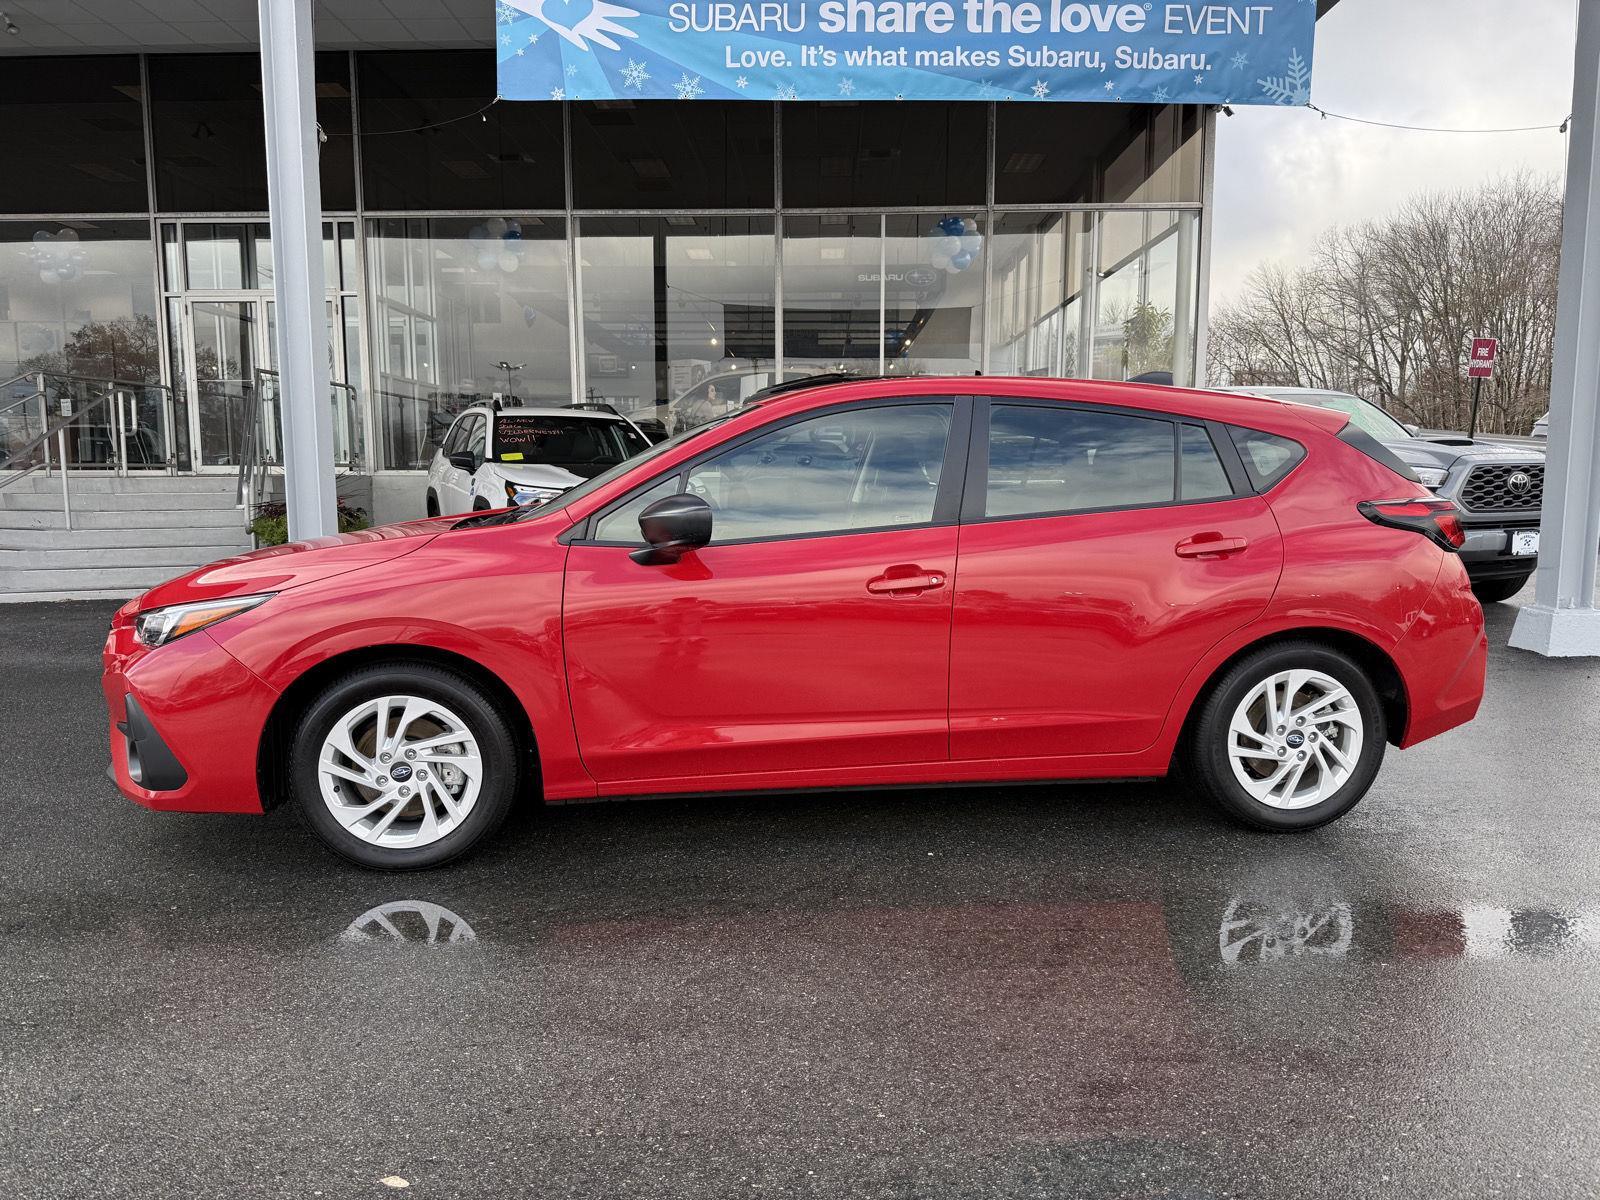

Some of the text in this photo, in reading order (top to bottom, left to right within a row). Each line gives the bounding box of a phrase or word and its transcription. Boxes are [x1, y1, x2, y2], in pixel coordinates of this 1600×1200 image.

[668, 2, 806, 33] SUBARU
[818, 0, 955, 34] share
[963, 0, 1042, 34] the
[1164, 4, 1274, 35] EVENT
[725, 45, 793, 68] Love.
[844, 45, 908, 67] what
[915, 46, 1001, 67] makes
[1008, 45, 1107, 72] Subaru,
[1114, 45, 1212, 71] Subaru.
[1477, 347, 1489, 357] FIRE
